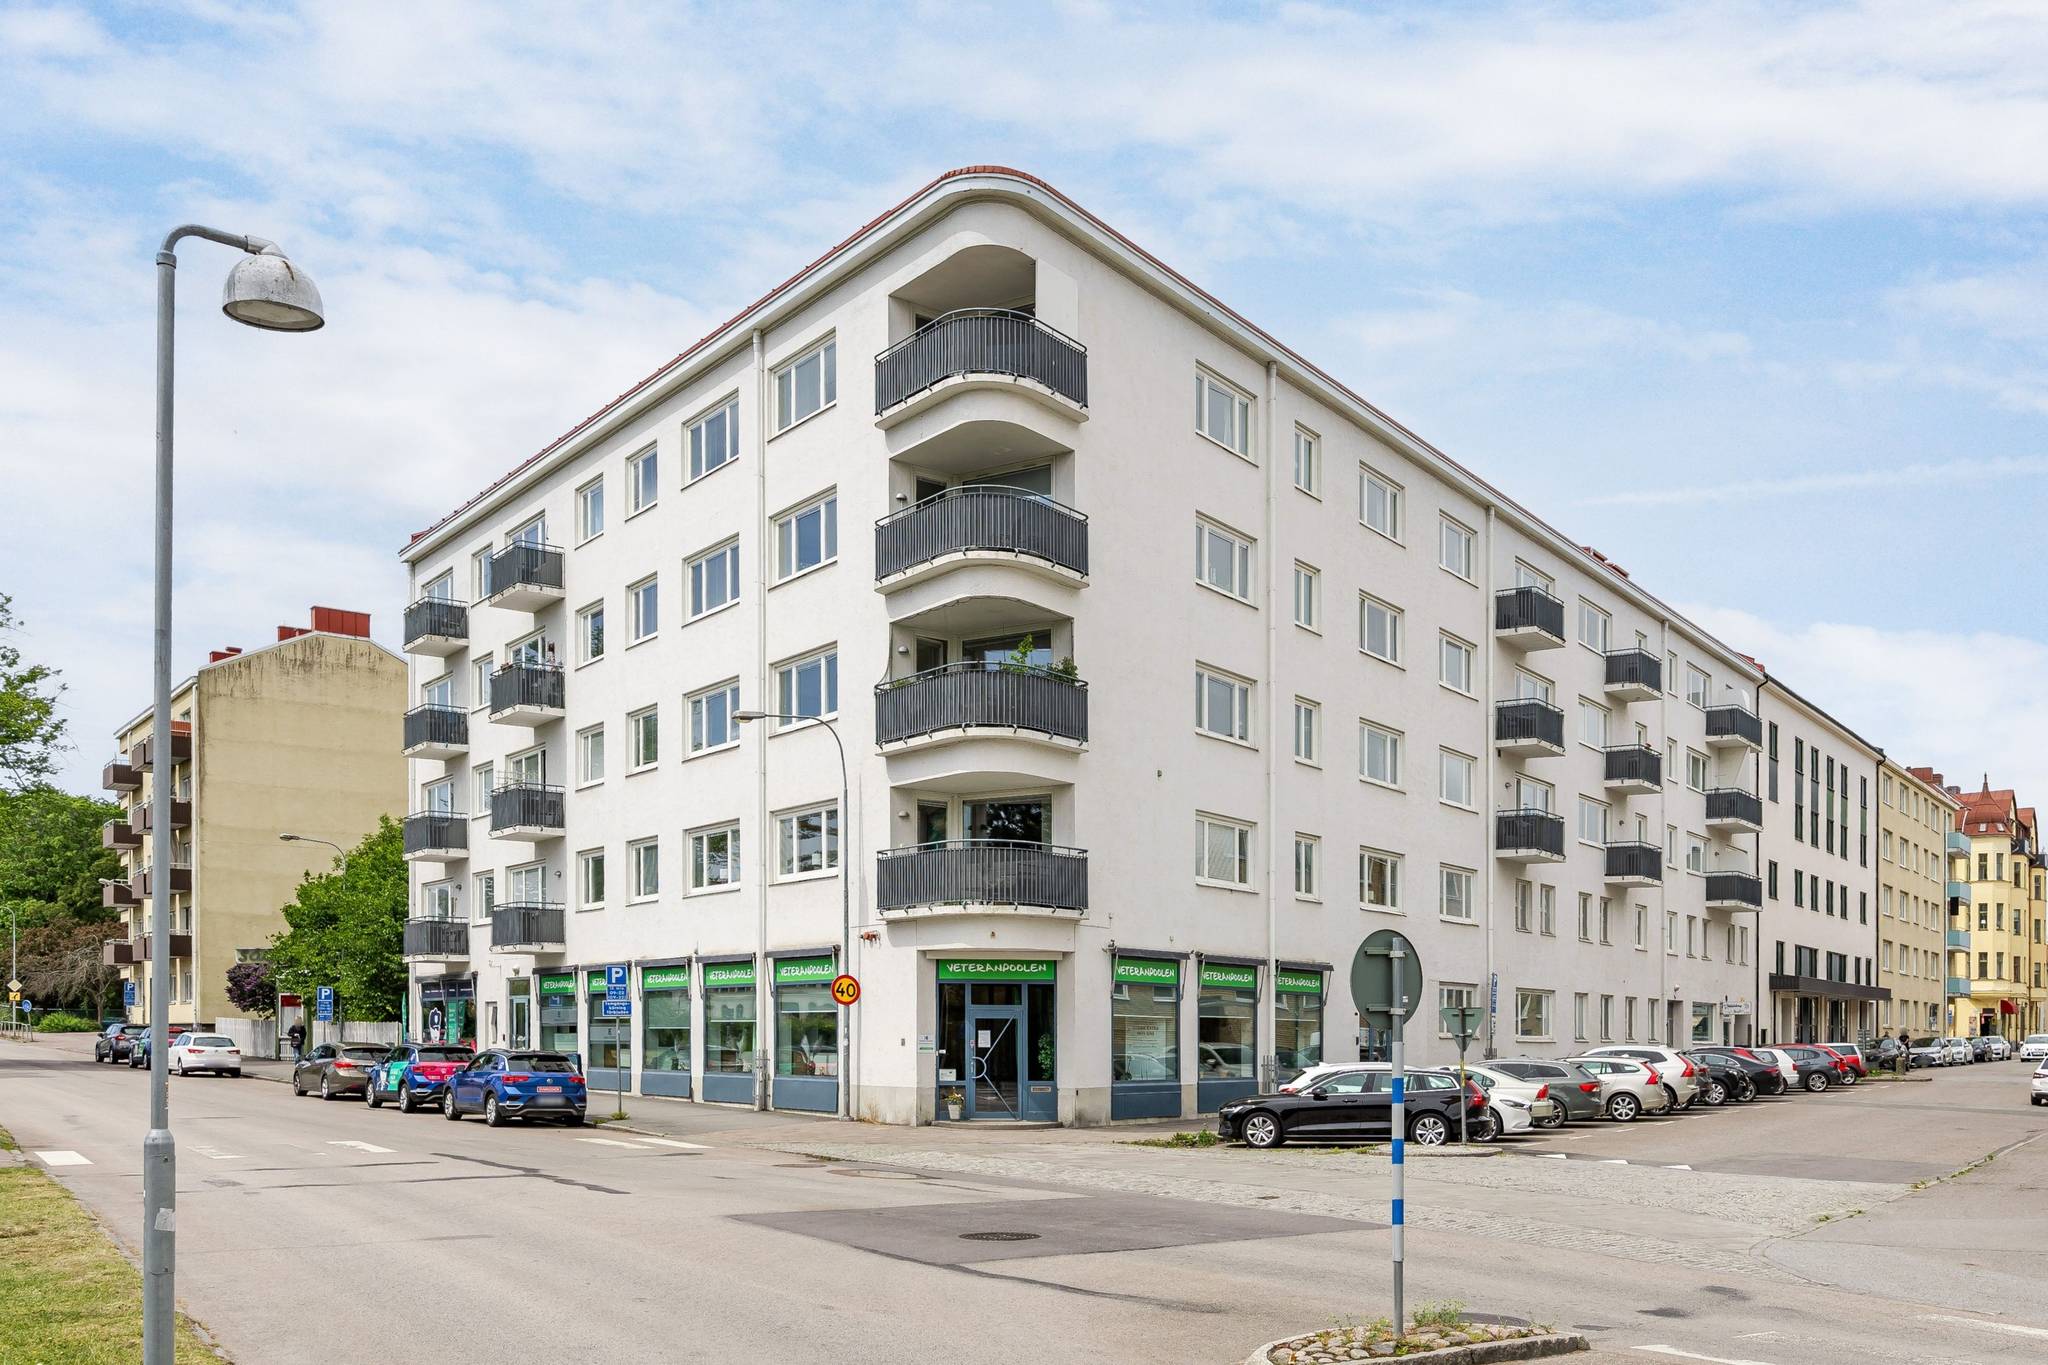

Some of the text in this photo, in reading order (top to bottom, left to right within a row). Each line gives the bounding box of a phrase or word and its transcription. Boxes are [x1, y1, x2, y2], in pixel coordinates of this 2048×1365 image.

[780, 965, 834, 977] VETERANPOOLEN
[947, 963, 1046, 972] VETERANPOOLEN
[1117, 966, 1174, 977] VETERANPOOLEN
[612, 967, 623, 983] P
[709, 969, 754, 980] VETERANPOOLEN
[1278, 977, 1320, 987] ETERANPOOLEN
[322, 989, 330, 999] P
[836, 983, 856, 997] 40
